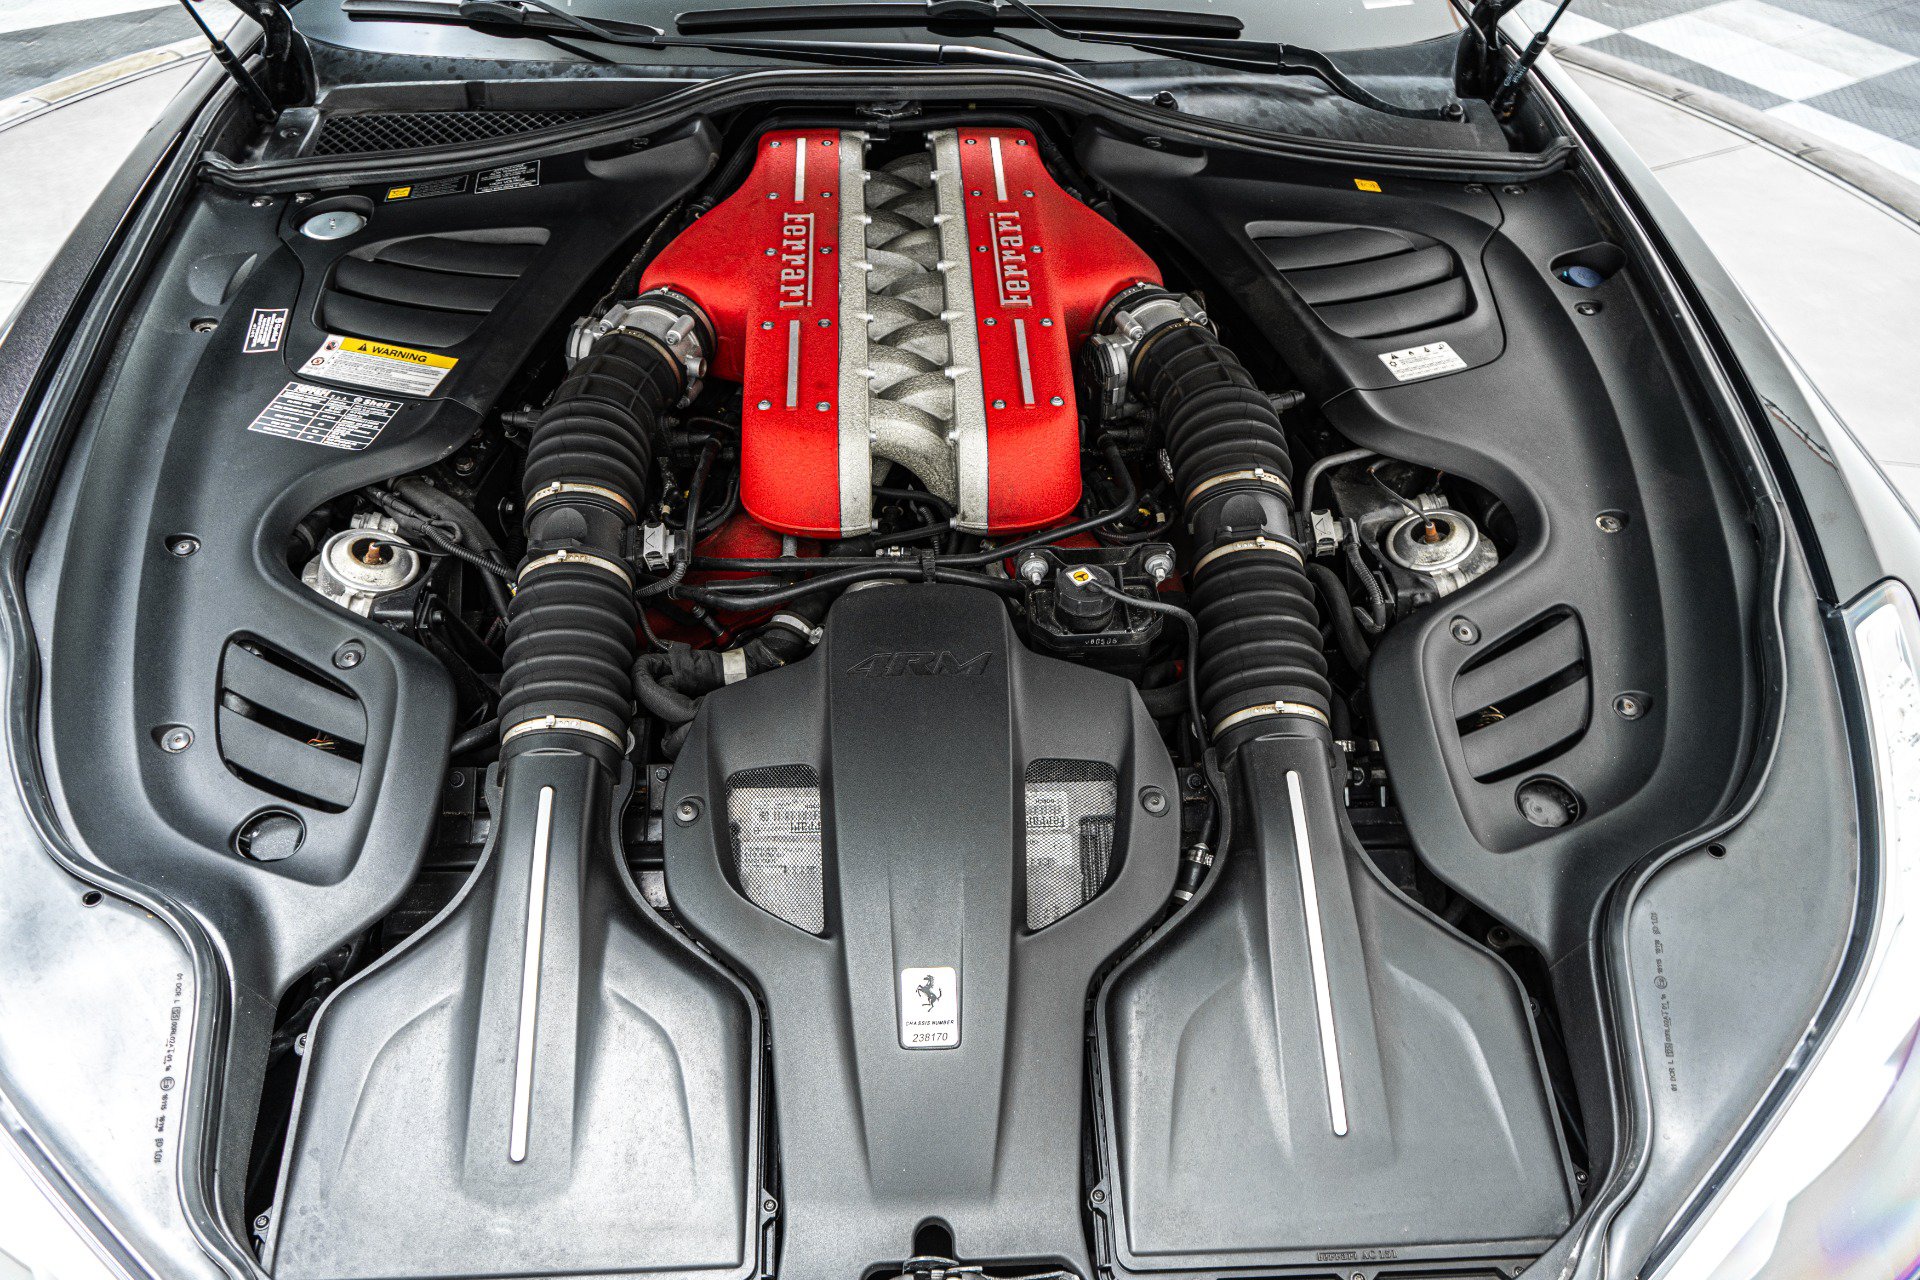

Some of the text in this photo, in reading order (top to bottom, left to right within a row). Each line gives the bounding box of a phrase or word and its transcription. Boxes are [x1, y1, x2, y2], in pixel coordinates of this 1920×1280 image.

[779, 212, 815, 308] Ferrari
[989, 211, 1033, 308] Ferrari
[372, 345, 428, 362] WARNING
[363, 398, 391, 408] Shell
[847, 651, 993, 677] 4RM
[912, 1032, 948, 1043] 238170
